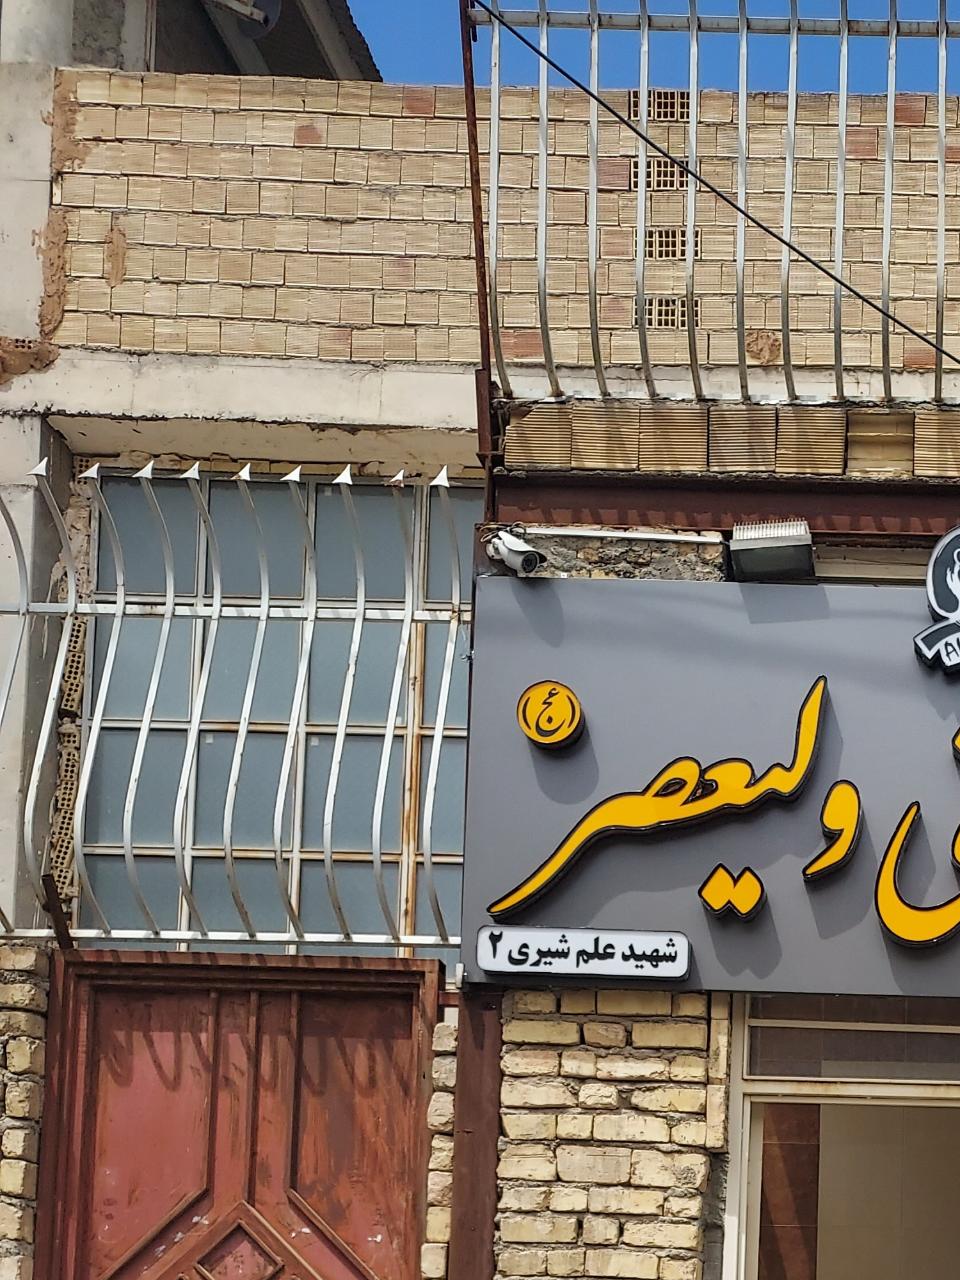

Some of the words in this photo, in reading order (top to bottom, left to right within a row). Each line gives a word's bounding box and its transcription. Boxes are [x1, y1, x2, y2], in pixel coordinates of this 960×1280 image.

[488, 929, 504, 960] ۲
[507, 932, 571, 968] شیری
[575, 935, 617, 969] علم
[620, 936, 679, 970] شهید
